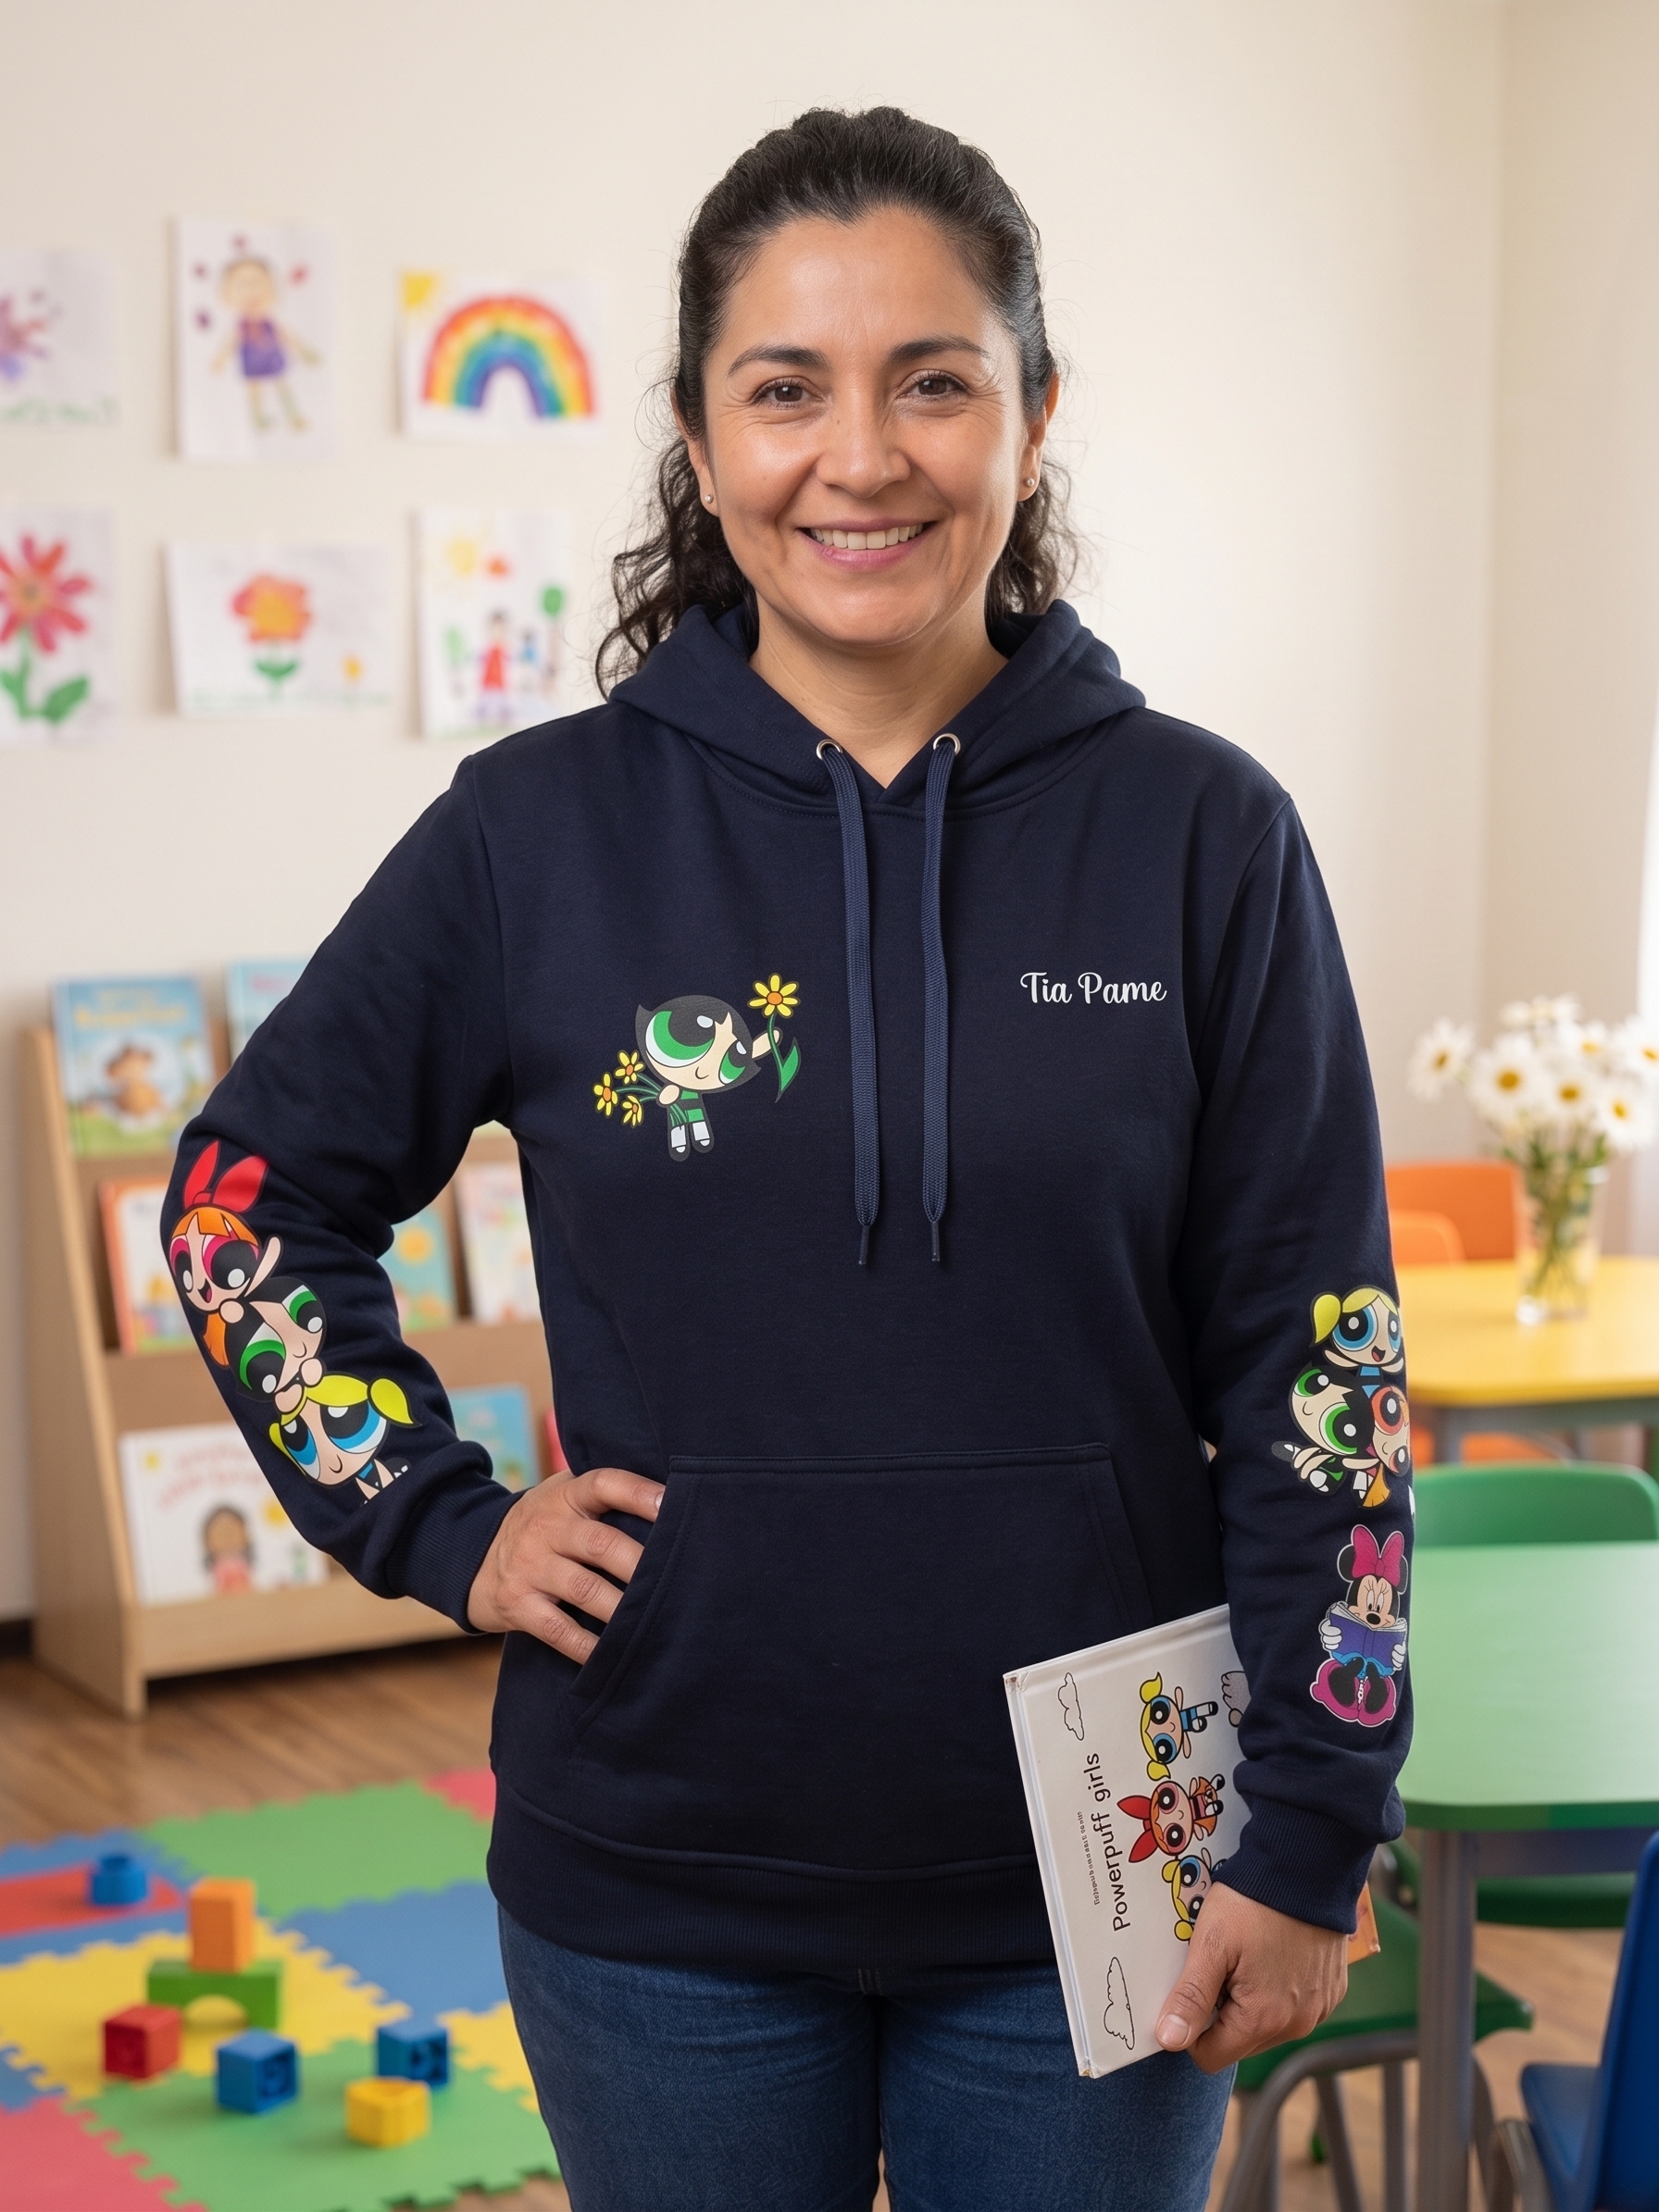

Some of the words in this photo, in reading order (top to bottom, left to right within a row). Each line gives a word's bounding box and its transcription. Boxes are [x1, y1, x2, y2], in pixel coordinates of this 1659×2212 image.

[1020, 972, 1072, 1004] Tia
[1078, 972, 1167, 1004] Pame
[1083, 1753, 1111, 1803] girls
[1091, 1812, 1131, 1932] Powerpuff
